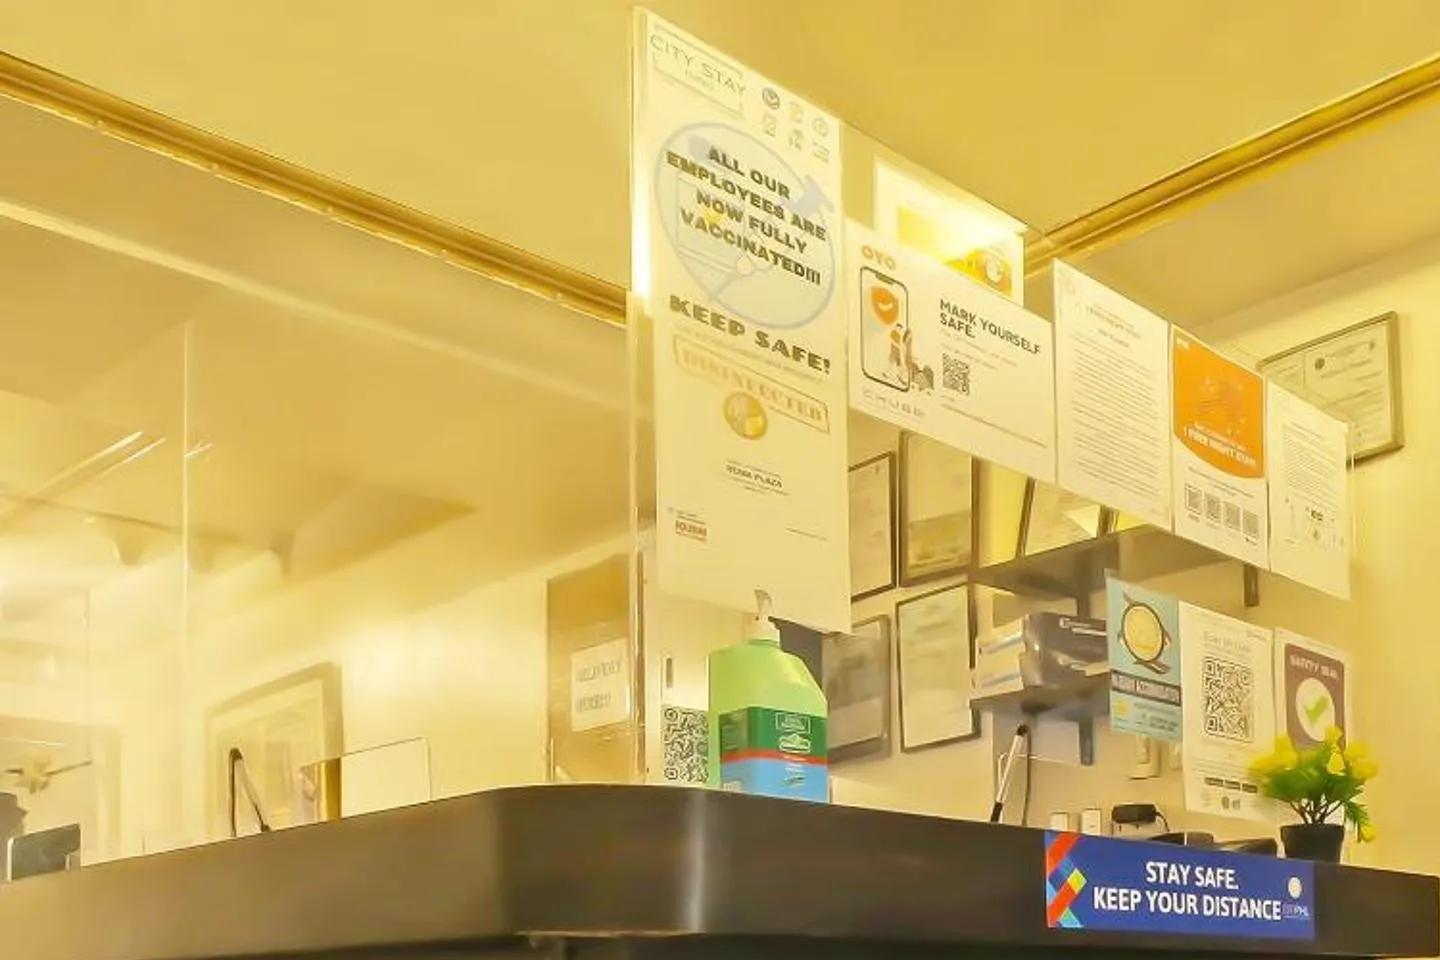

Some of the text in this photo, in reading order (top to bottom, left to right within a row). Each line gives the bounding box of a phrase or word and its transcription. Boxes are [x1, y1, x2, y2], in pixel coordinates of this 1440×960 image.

[650, 34, 746, 95] CITY STAY
[666, 150, 826, 241] EMPLOYEES ARE
[709, 147, 790, 200] ALL OUR
[680, 207, 821, 286] VACCINATED!!!
[696, 189, 807, 254] NOW FULLY
[861, 245, 897, 271] OYO
[669, 294, 745, 337] KEEP
[755, 331, 830, 375] SAFE!
[940, 298, 977, 326] MARK
[979, 317, 1041, 354] YOURSELF
[1093, 887, 1141, 912] KEEP
[1146, 892, 1198, 916] YOUR
[1202, 898, 1281, 921] DISTANCE
[1146, 861, 1239, 890] STAY SAFE.
